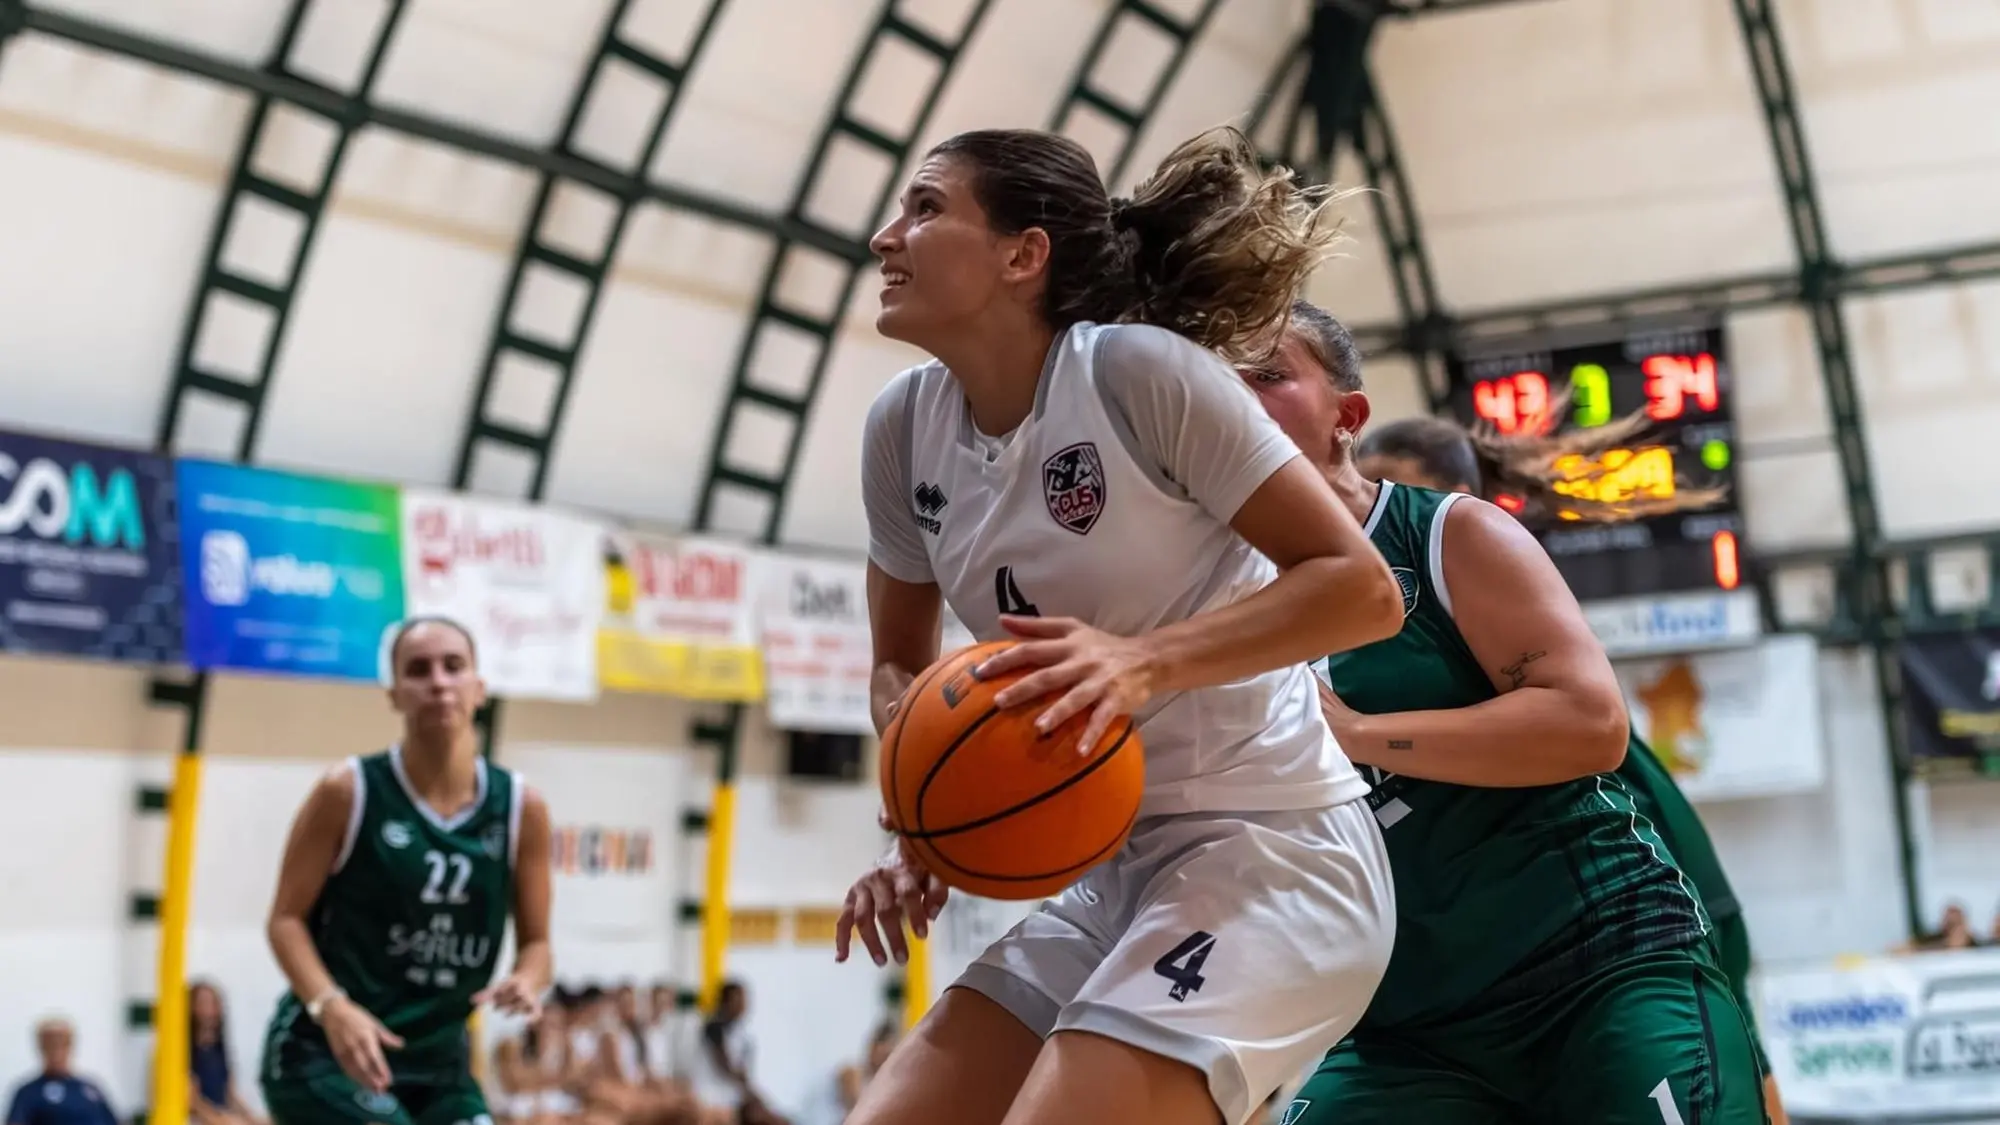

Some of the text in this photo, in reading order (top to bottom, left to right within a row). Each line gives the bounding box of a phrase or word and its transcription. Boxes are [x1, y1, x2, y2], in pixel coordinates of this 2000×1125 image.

[1643, 352, 1719, 421] 34
[420, 850, 473, 904] 22
[1153, 930, 1218, 1003] 4
